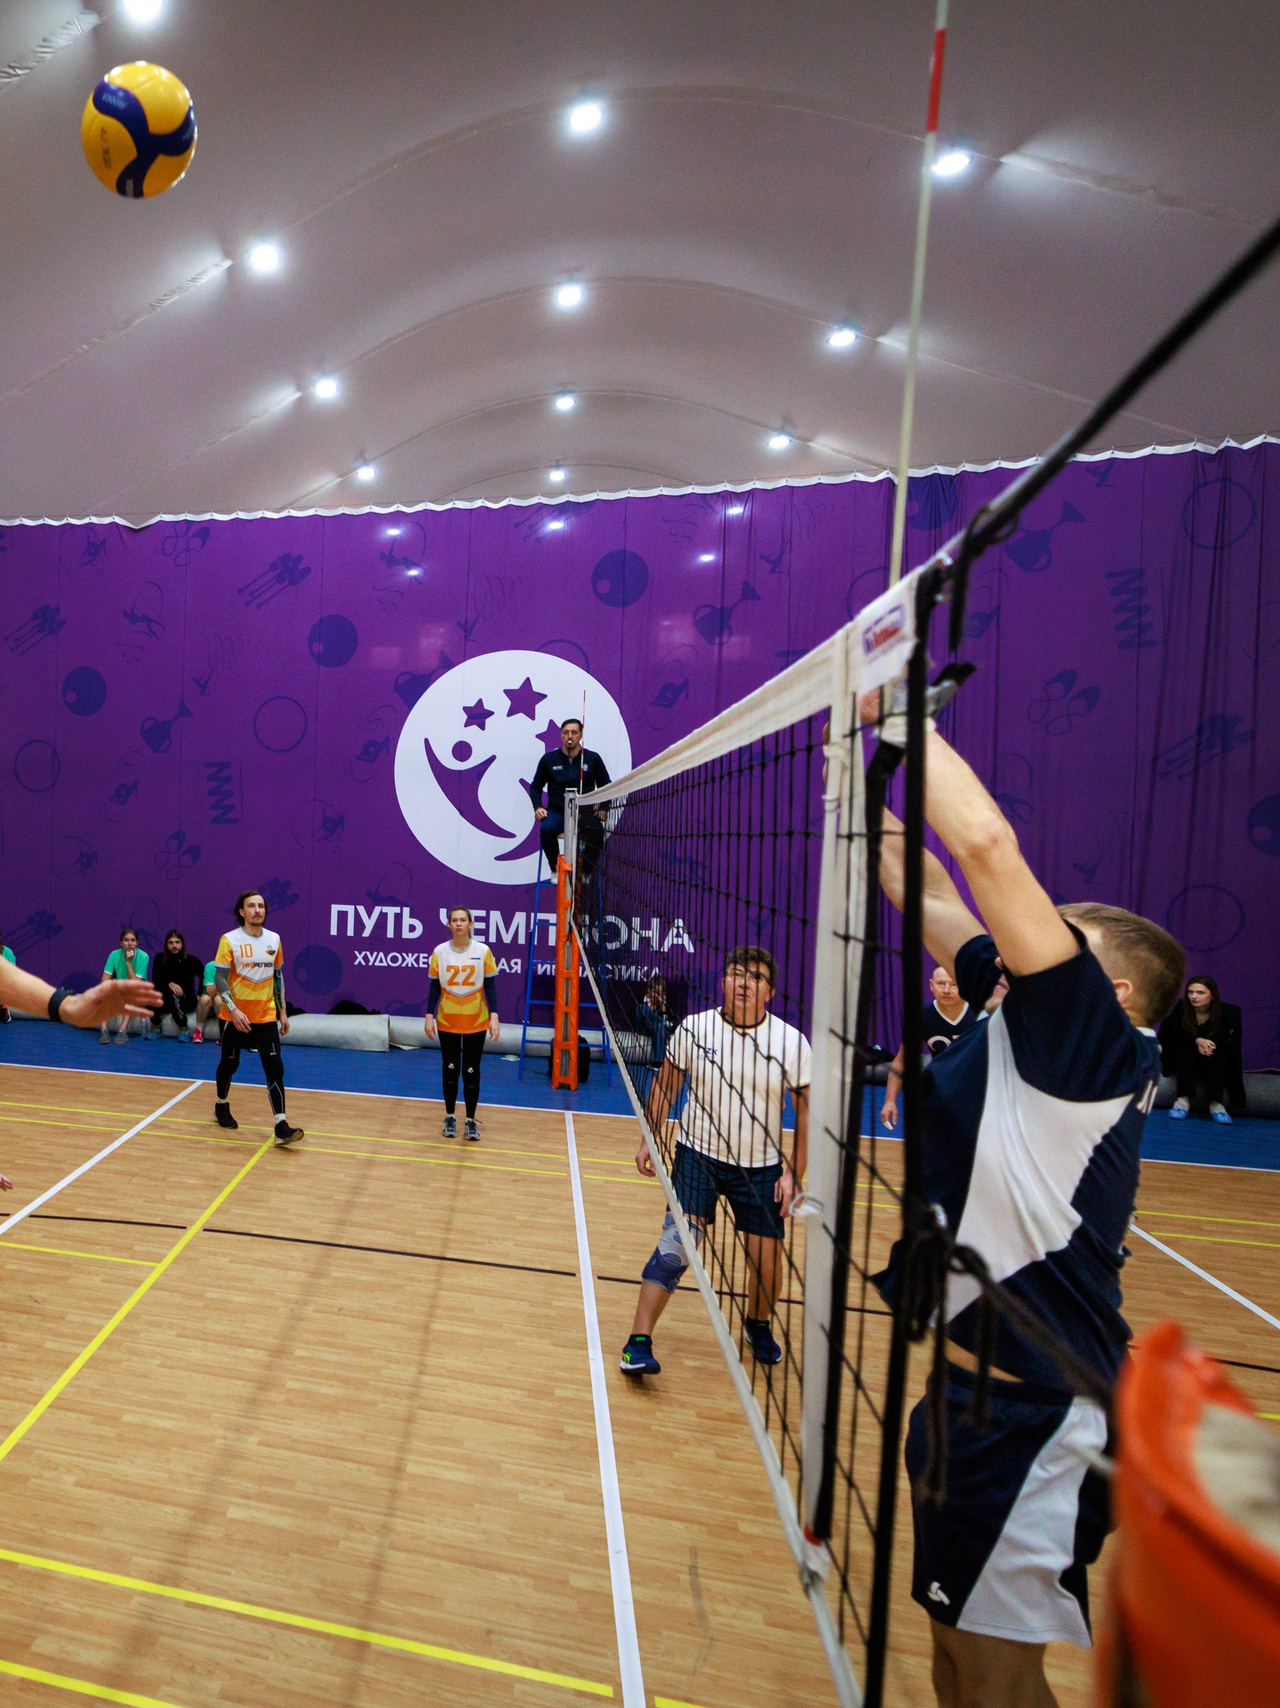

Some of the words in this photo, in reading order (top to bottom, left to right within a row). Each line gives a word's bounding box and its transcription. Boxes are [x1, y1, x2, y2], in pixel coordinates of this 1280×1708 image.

[330, 904, 424, 939] ПУТЬ
[239, 943, 253, 959] 10
[446, 964, 476, 986] 22
